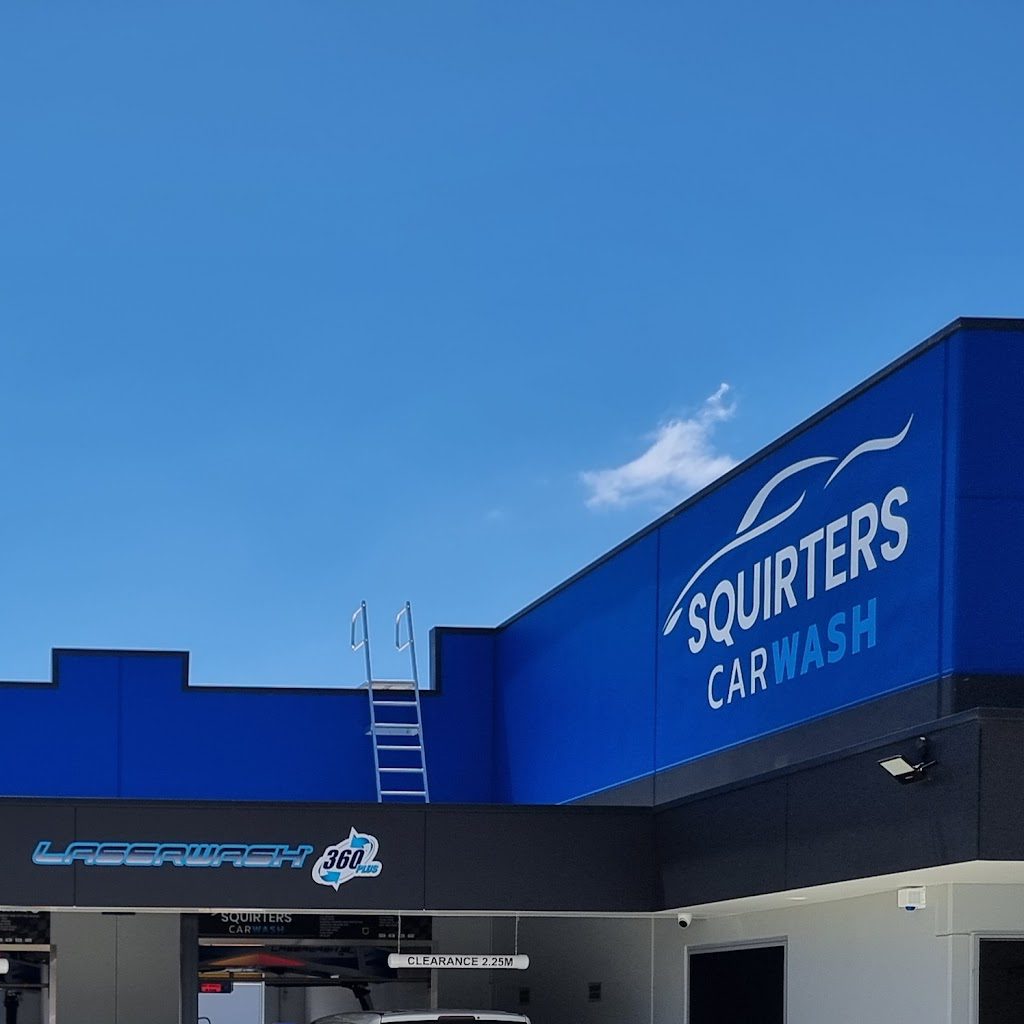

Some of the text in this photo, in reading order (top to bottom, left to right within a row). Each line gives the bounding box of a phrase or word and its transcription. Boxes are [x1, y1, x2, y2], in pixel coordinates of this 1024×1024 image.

[688, 486, 909, 654] SQUIRTERS
[32, 841, 379, 873] LASERWASH 360 PLUS
[221, 913, 292, 924] SQUIRTERS
[407, 956, 514, 967] CLEARANCE 2.25M
